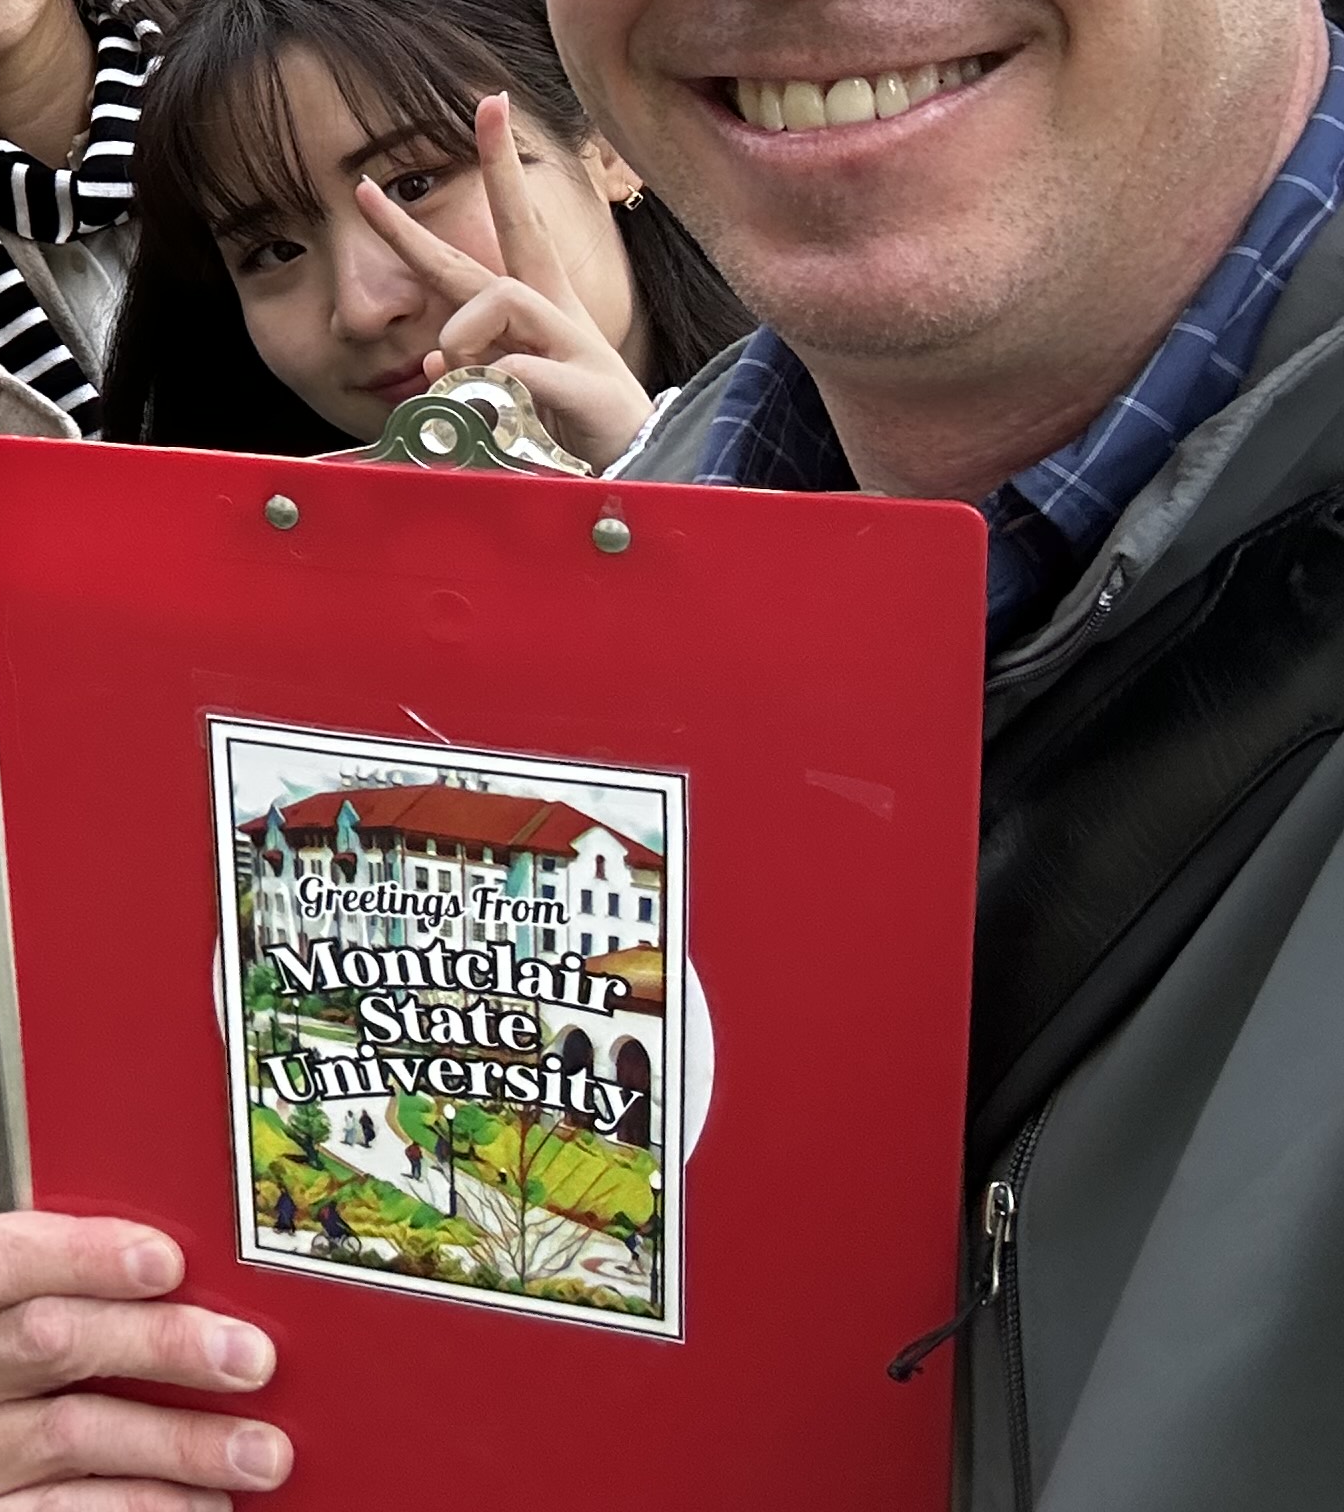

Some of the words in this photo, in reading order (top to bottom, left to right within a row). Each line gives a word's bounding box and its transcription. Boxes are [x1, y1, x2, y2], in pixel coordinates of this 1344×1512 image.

[299, 875, 465, 928] Greetings
[471, 883, 571, 927] From
[266, 938, 630, 1018] Montclair
[359, 995, 543, 1054] State
[262, 1044, 645, 1134] University
